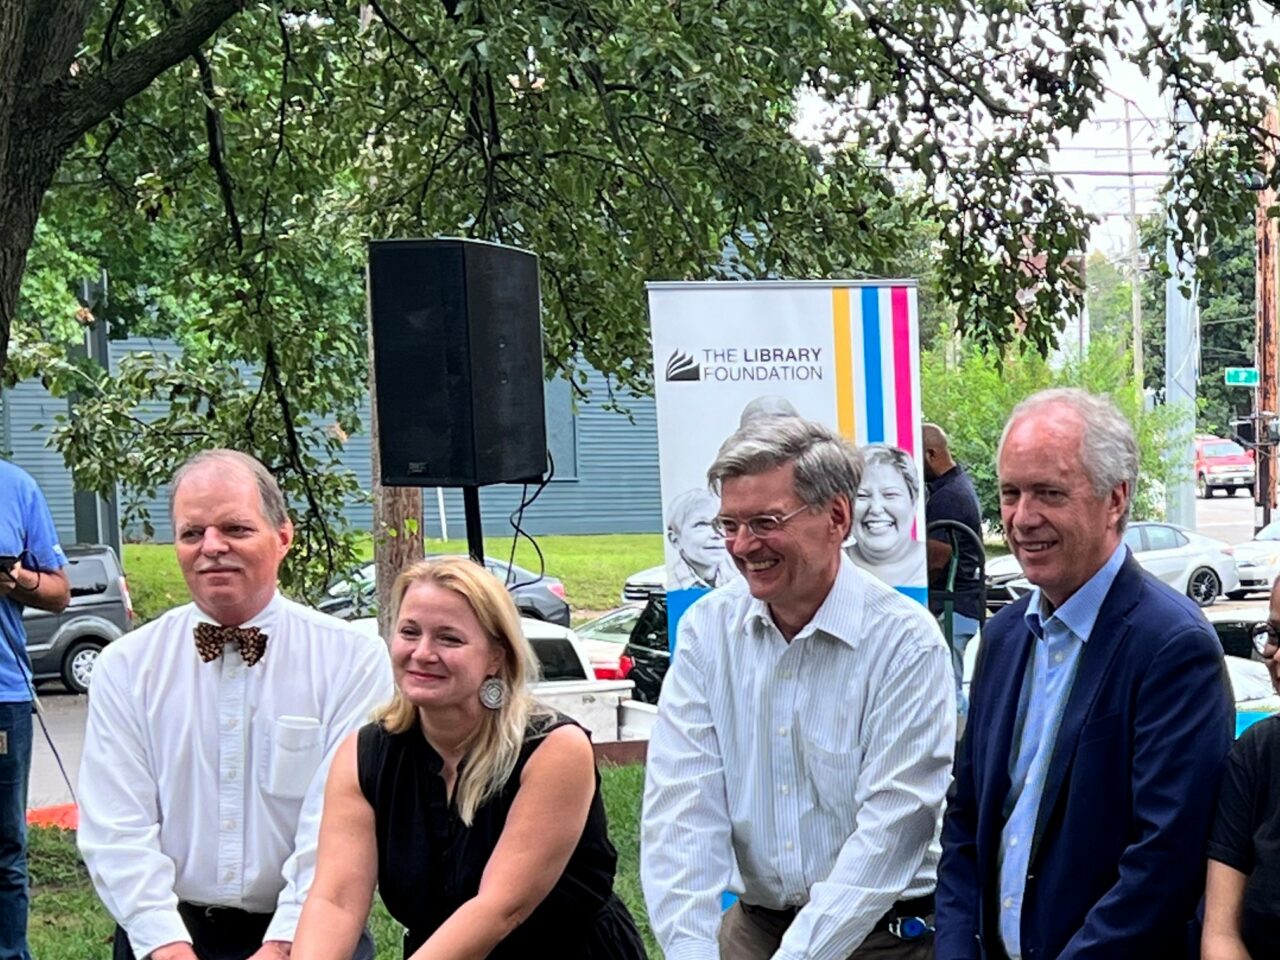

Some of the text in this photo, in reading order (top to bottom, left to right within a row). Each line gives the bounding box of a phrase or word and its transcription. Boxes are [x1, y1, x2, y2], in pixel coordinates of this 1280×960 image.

[702, 348, 822, 363] THE LIBRARY
[704, 365, 823, 381] FOUNDATION
